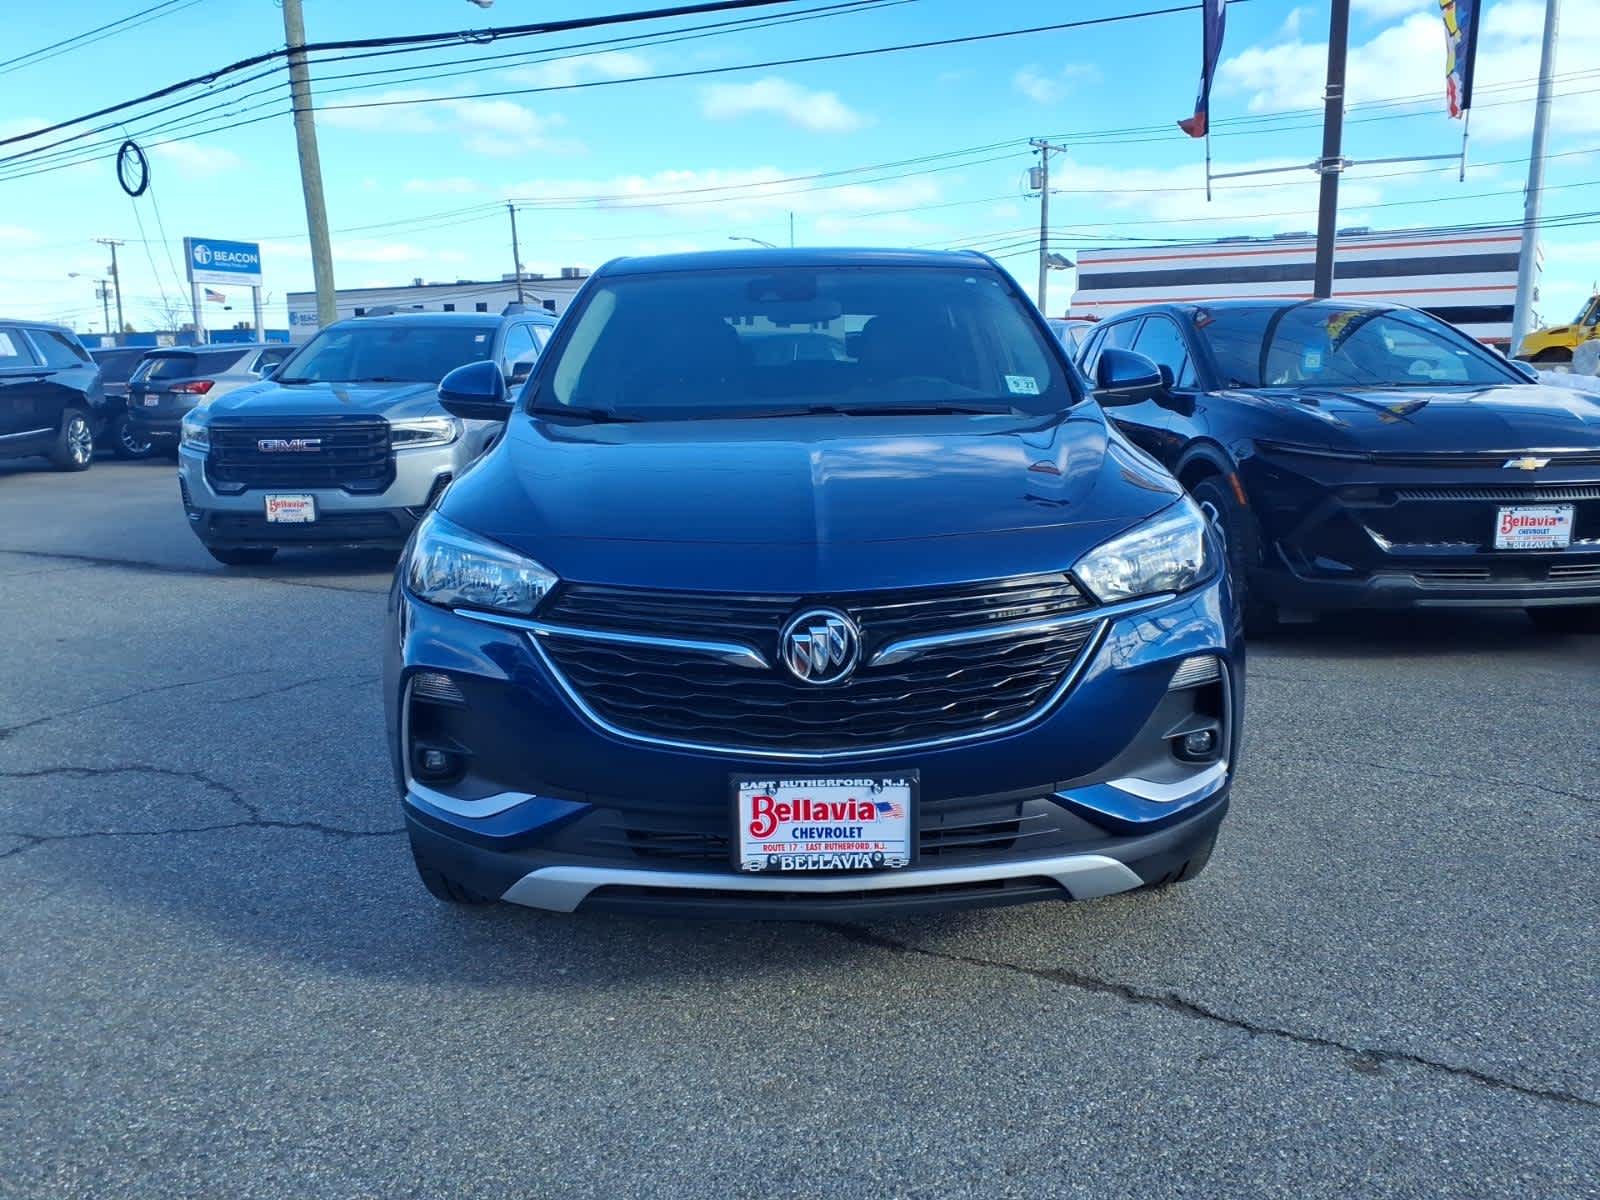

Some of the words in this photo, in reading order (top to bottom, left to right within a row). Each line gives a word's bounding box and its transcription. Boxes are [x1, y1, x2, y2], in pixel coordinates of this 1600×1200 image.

[214, 251, 257, 264] BEACON
[258, 439, 321, 452] GMC
[1501, 514, 1557, 534] Bellavia
[740, 782, 775, 790] EAST
[882, 778, 910, 787] N.J.
[750, 796, 876, 838] Bellavia
[792, 826, 863, 839] CHEVROLET
[763, 844, 785, 852] ROUTE
[789, 843, 798, 852] 17
[806, 843, 821, 852] EAST
[781, 853, 874, 871] BELLAVIA
